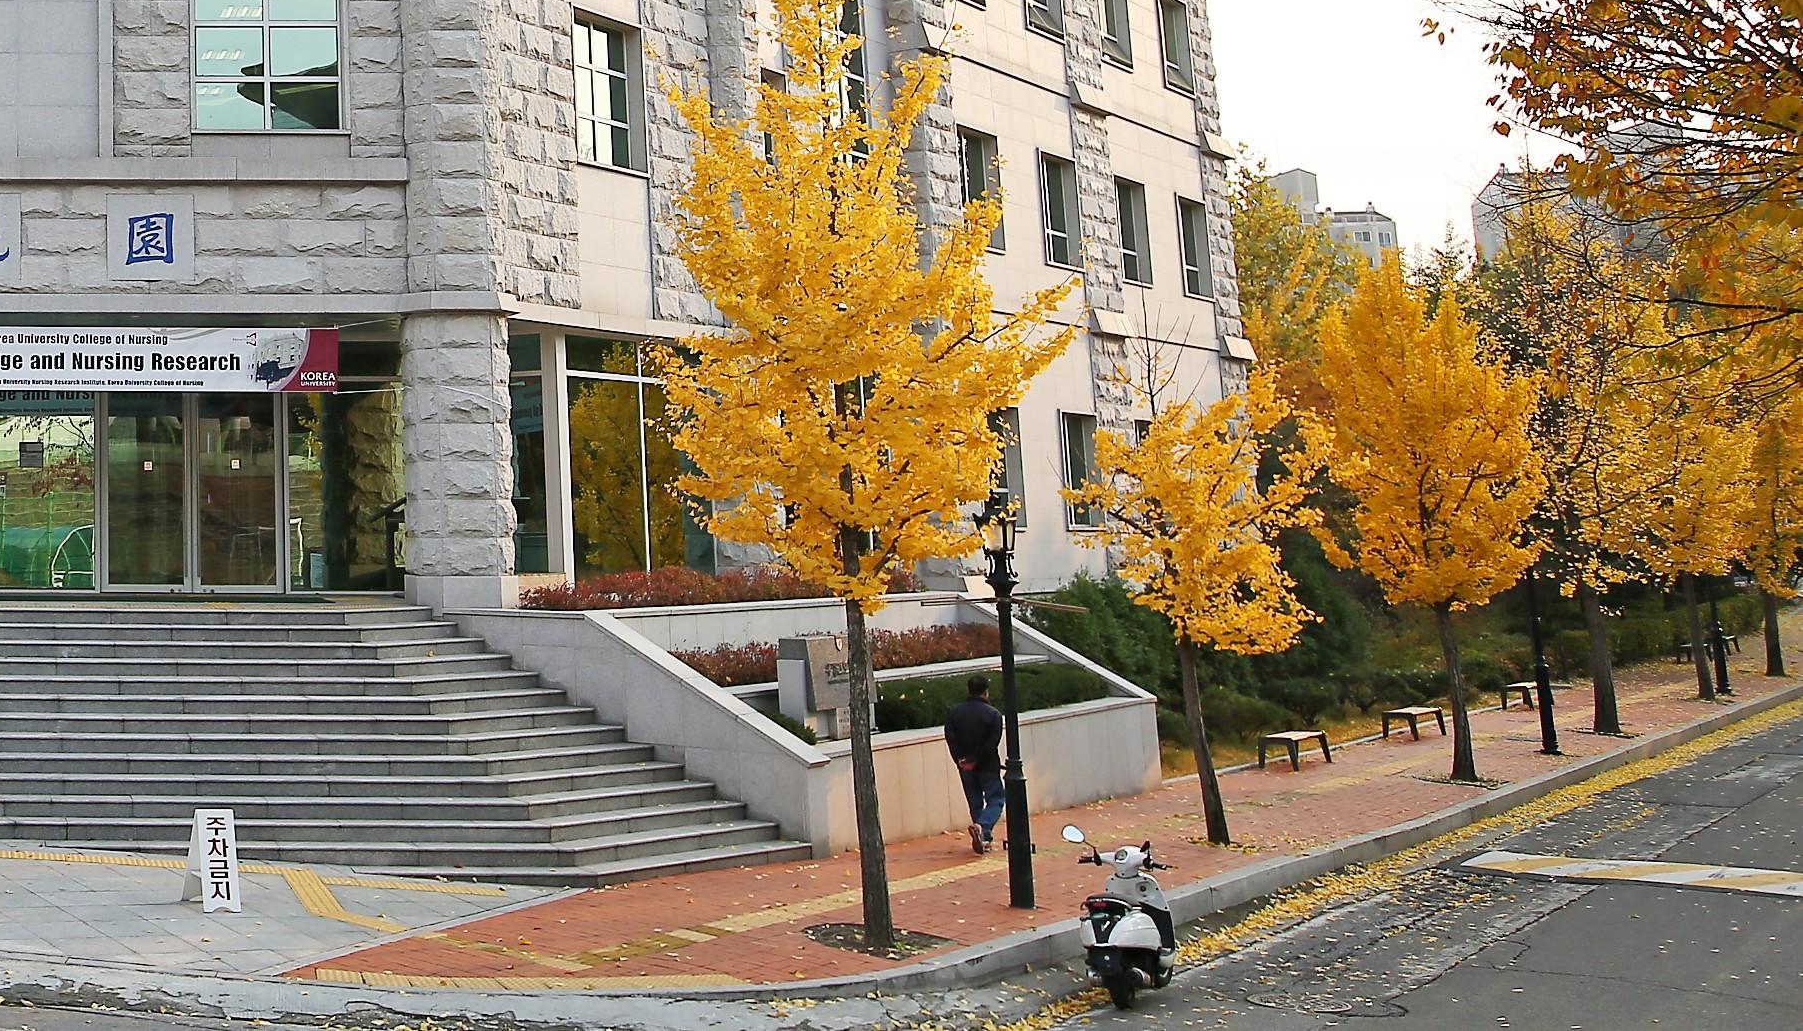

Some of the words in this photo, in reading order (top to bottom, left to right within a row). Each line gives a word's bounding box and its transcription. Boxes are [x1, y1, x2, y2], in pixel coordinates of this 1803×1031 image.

[17, 334, 70, 345] University
[72, 334, 112, 346] College
[115, 335, 125, 345] of
[128, 335, 168, 346] Nursing
[30, 352, 65, 370] and
[72, 352, 144, 372] Nursing
[151, 353, 241, 371] Research
[300, 372, 336, 381] KOREA
[206, 817, 231, 900] 주차금지
